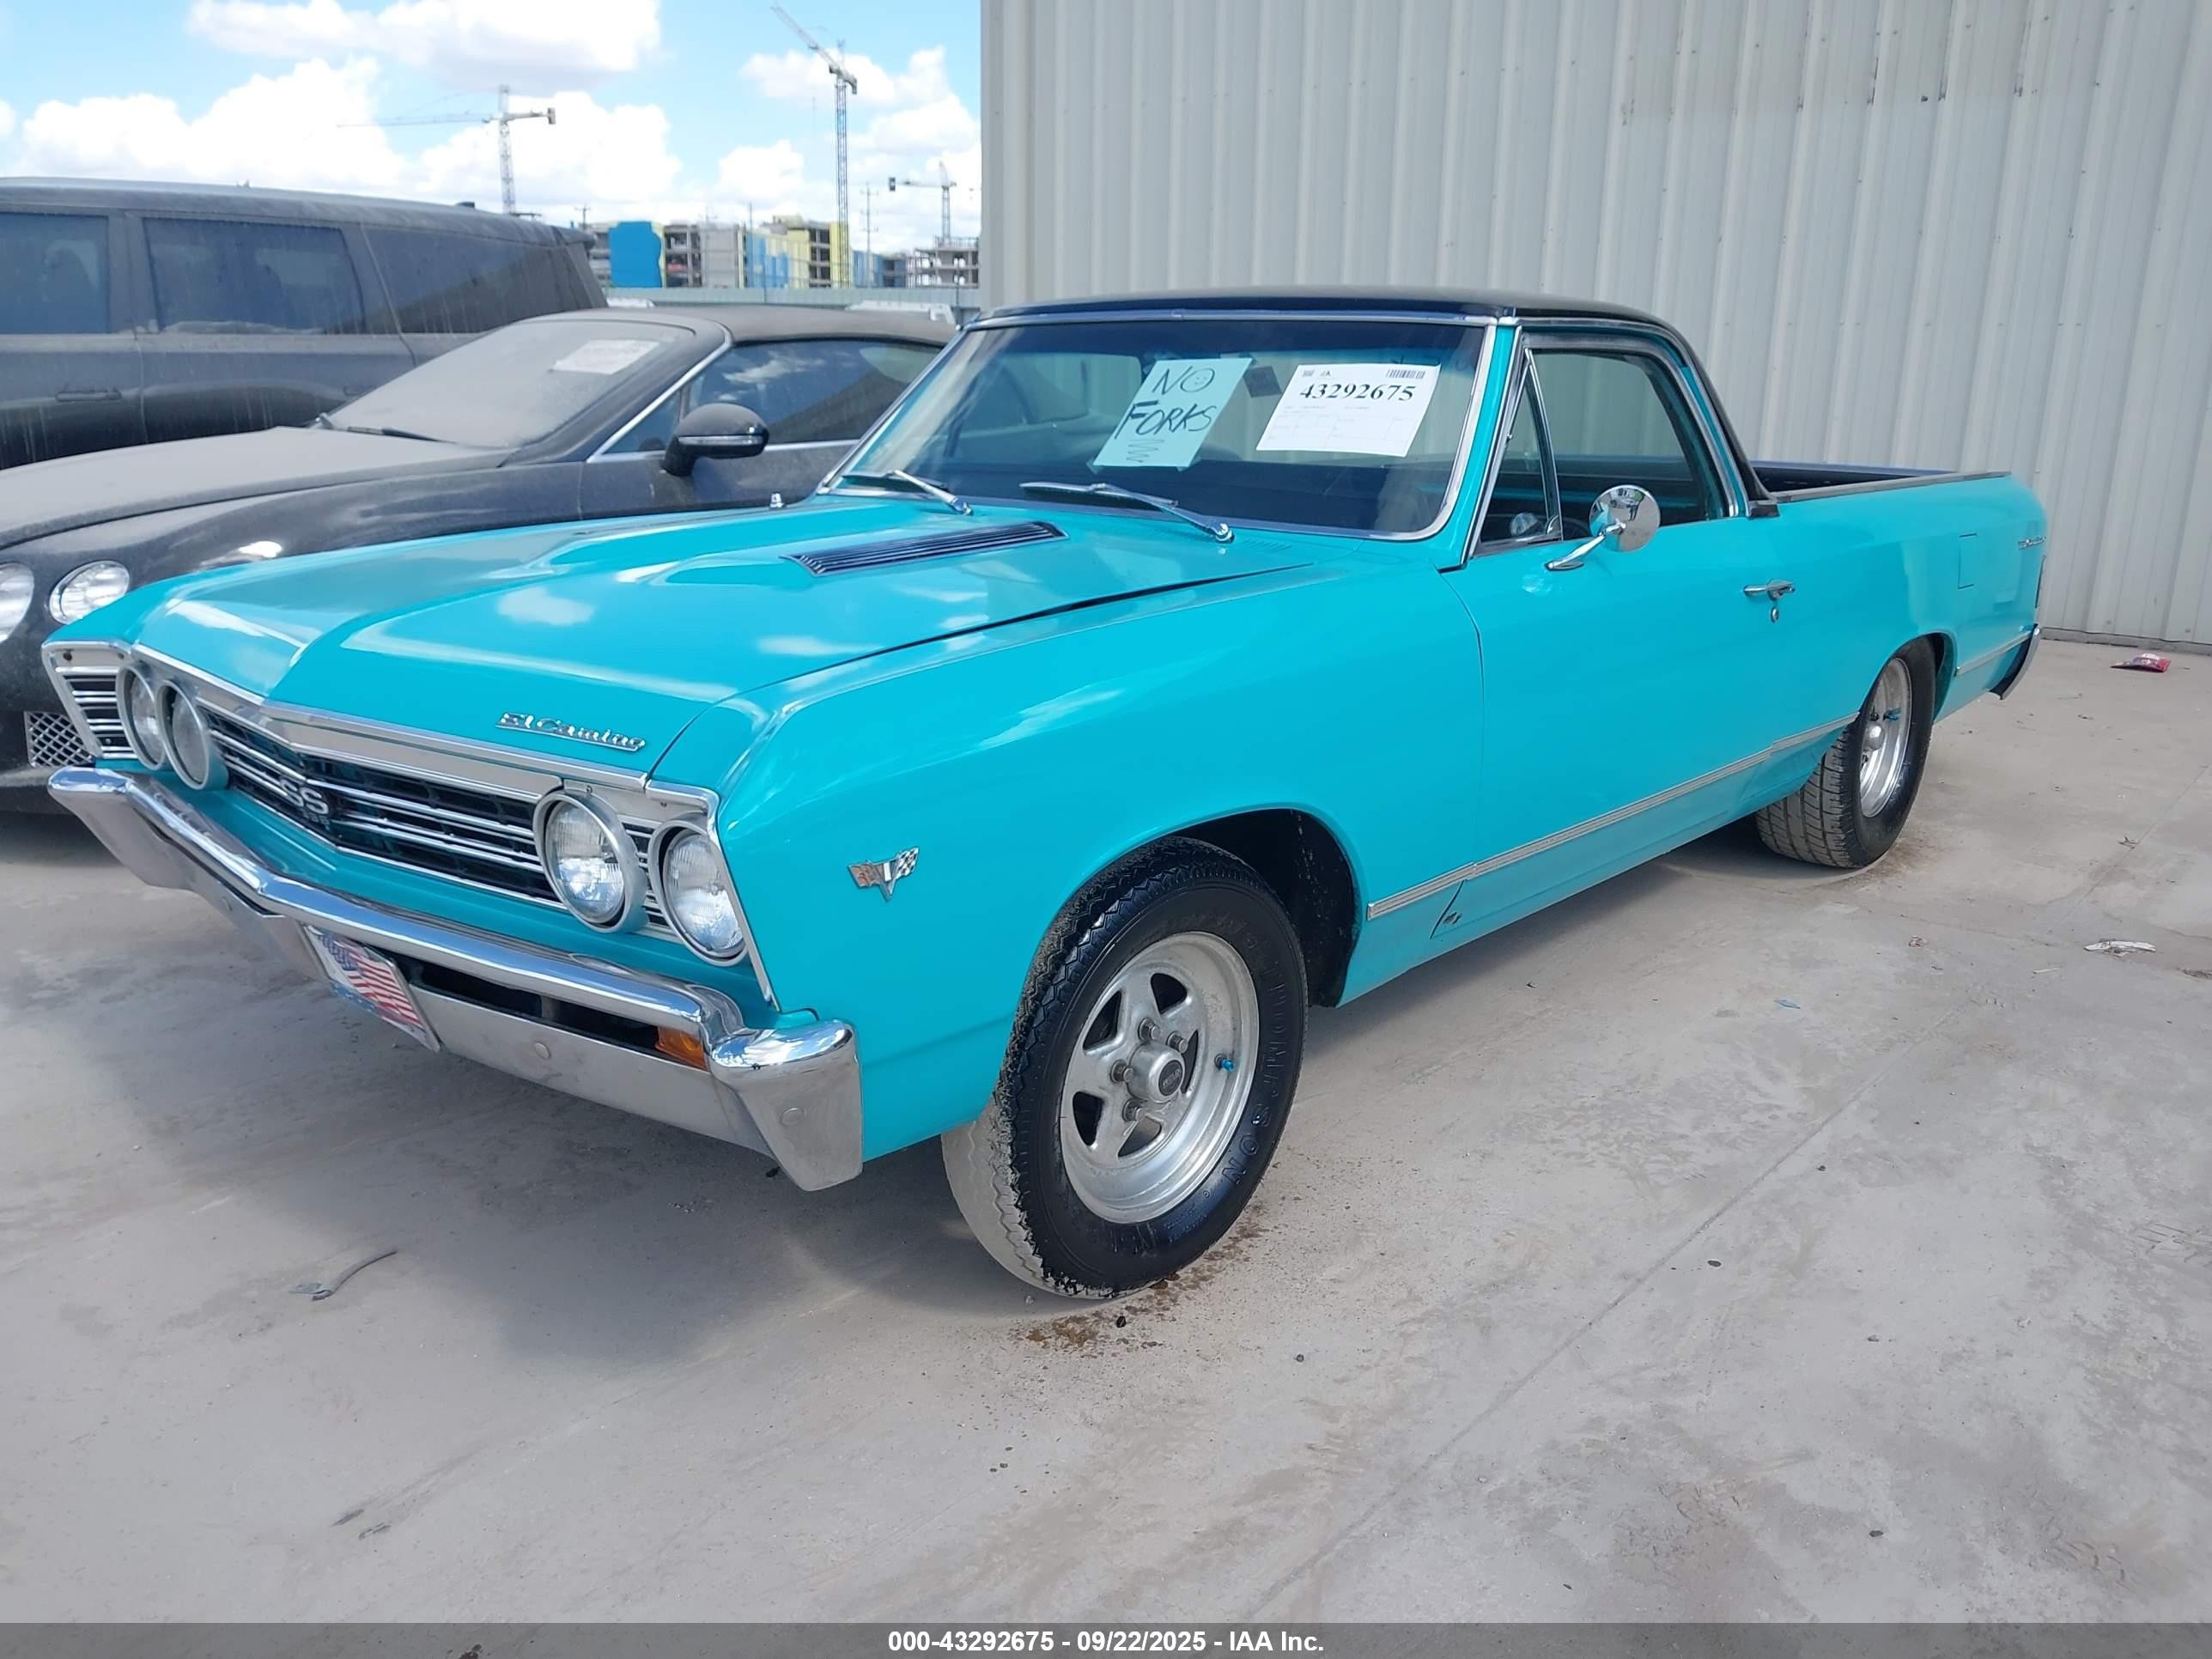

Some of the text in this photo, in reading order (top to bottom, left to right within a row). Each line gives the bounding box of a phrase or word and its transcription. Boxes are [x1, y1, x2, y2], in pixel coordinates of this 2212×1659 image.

[1152, 365, 1216, 395] NO
[1299, 383, 1417, 402] 43292675
[1114, 399, 1218, 440] FORKS
[536, 718, 646, 747] Camino
[279, 776, 329, 815] SS
